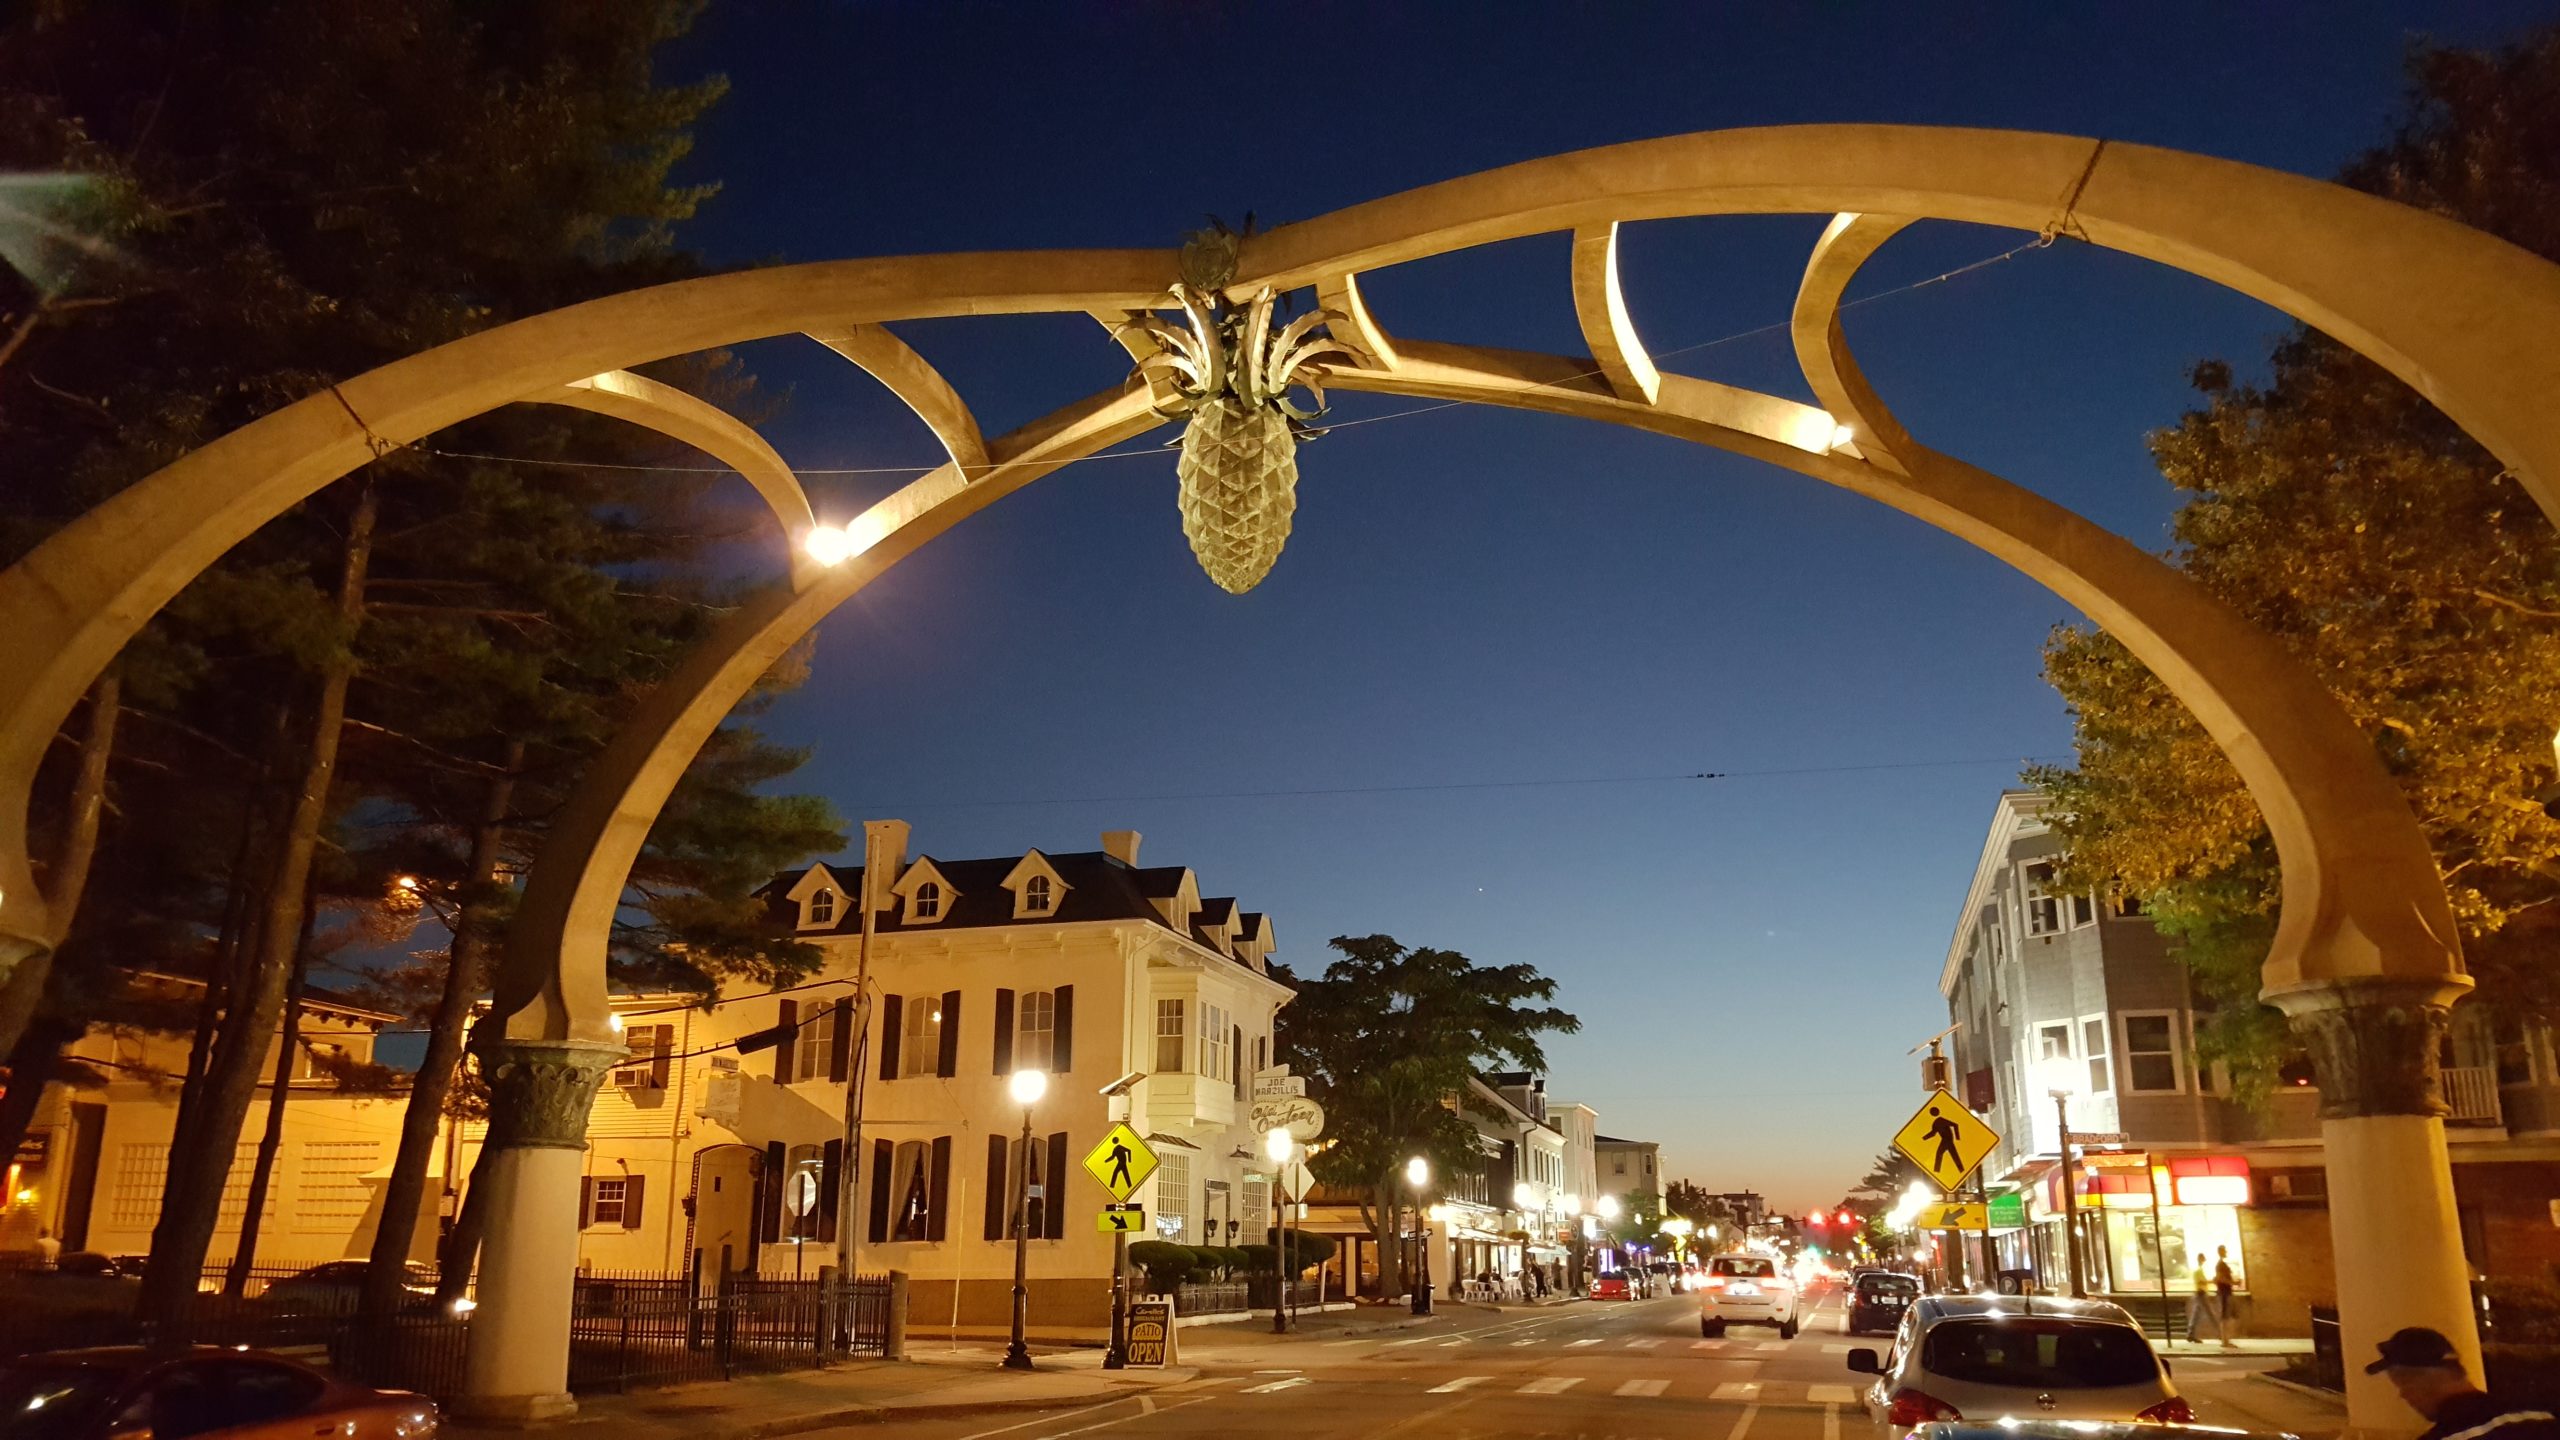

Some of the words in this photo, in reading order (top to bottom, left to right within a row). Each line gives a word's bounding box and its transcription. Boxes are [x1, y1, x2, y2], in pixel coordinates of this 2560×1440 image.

[1267, 1078, 1285, 1086] JOE
[2072, 1134, 2119, 1144] BRADFORD
[1135, 1325, 1161, 1337] PATIO
[1128, 1342, 1164, 1363] OPEN
